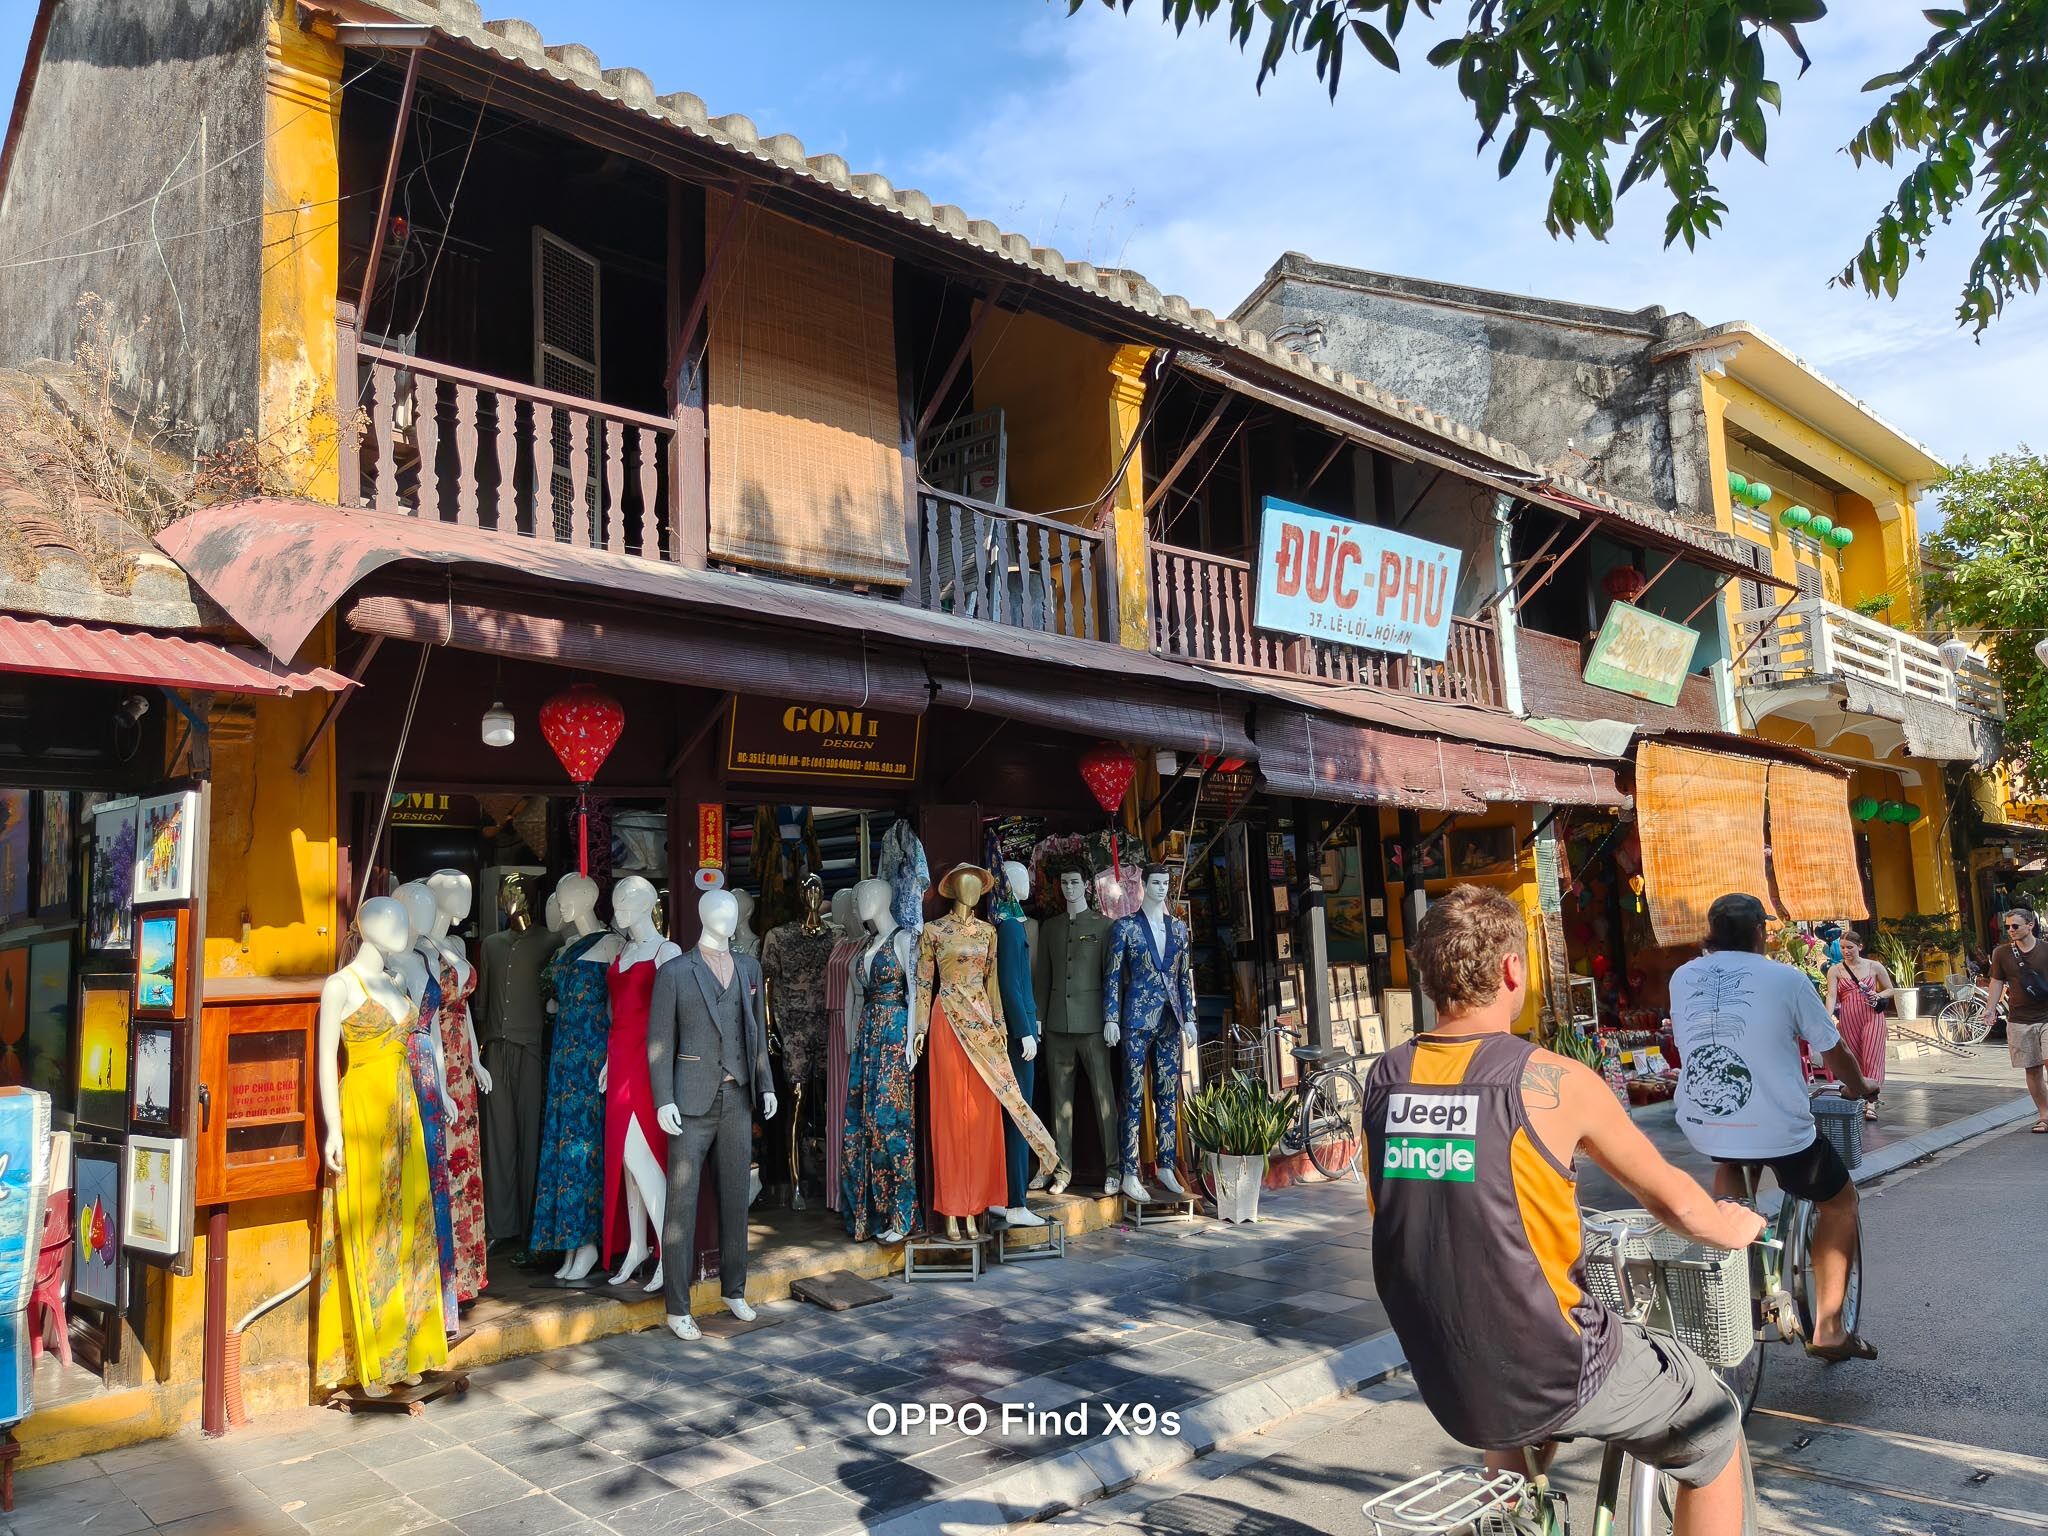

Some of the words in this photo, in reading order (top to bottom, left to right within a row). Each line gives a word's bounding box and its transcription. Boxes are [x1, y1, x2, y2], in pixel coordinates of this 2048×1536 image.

[782, 706, 865, 736] GOM
[822, 738, 875, 749] DESIGN
[391, 812, 445, 821] DESIGN
[257, 1093, 294, 1103] CABINET
[1390, 1096, 1467, 1131] Jeep
[1383, 1138, 1474, 1179] bingle
